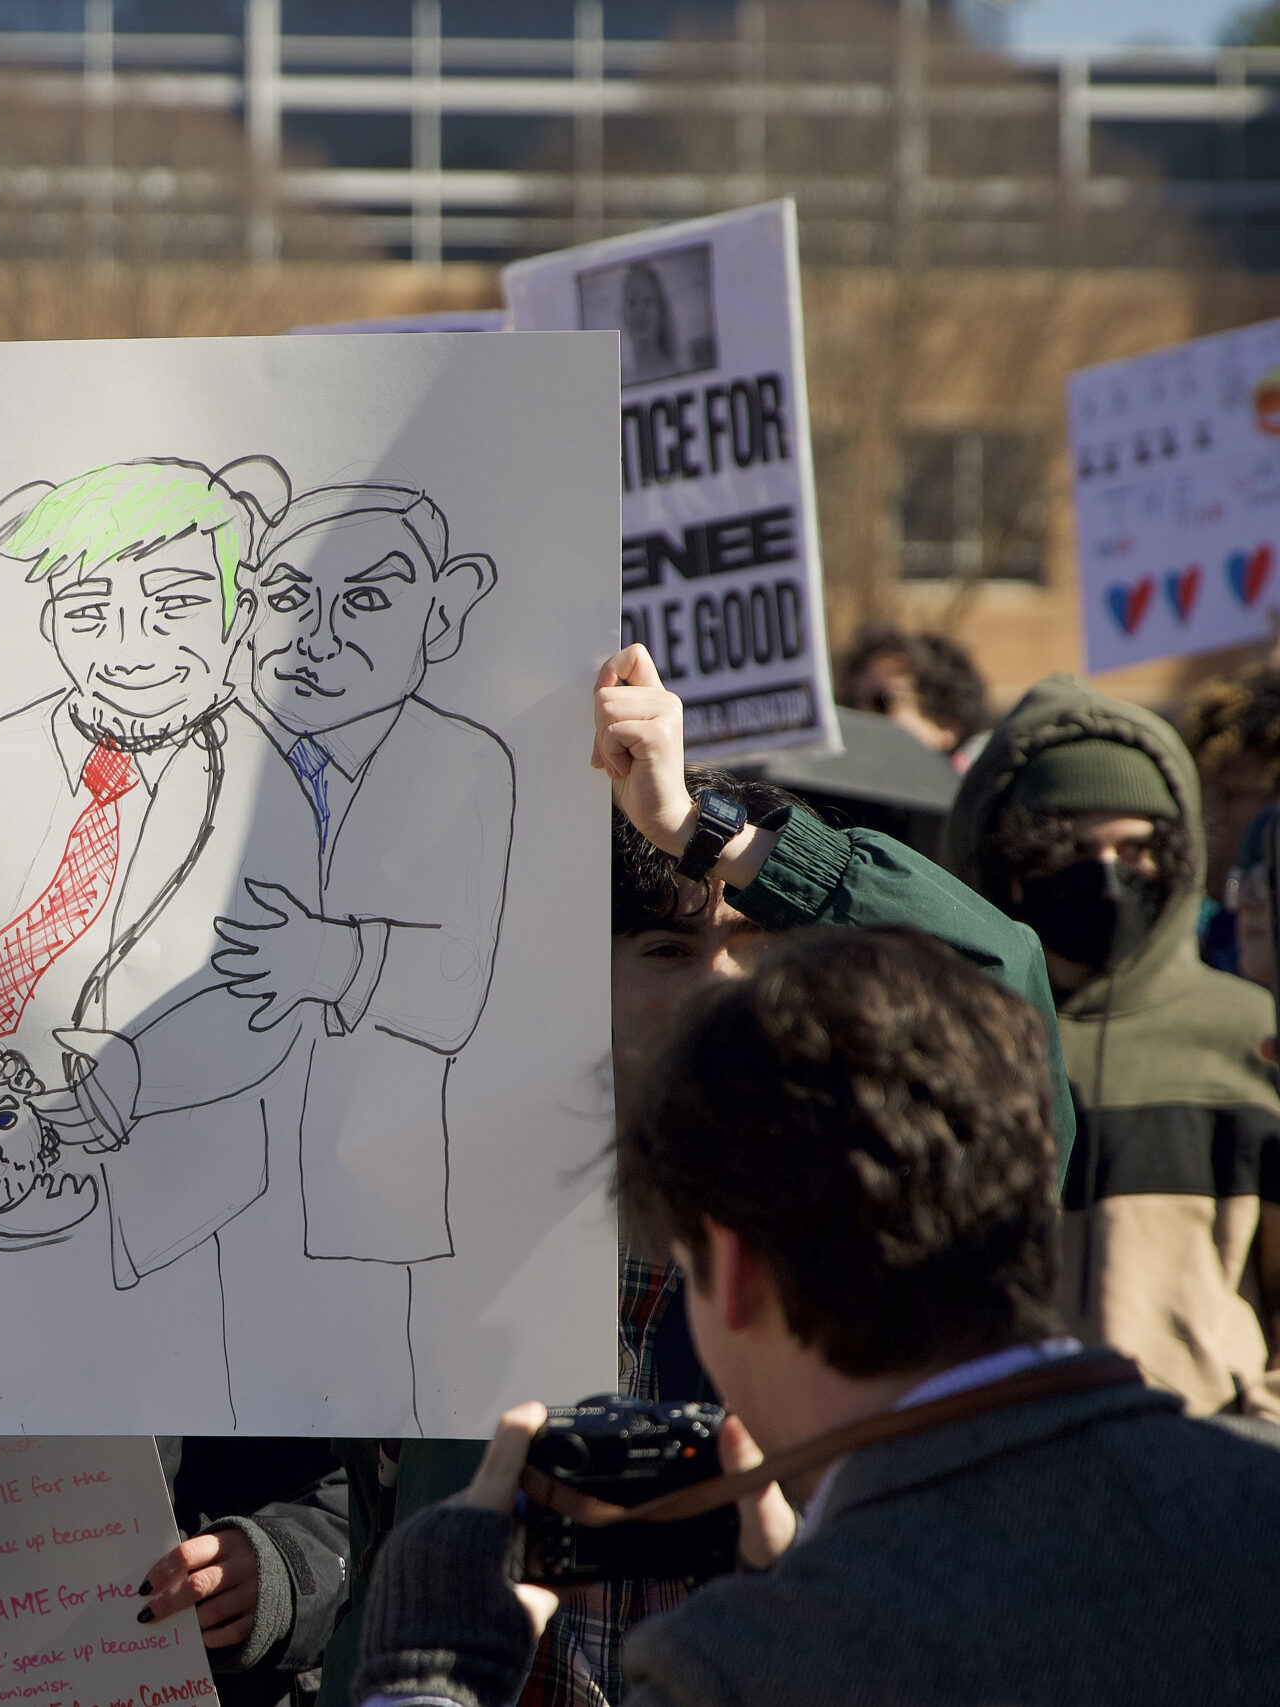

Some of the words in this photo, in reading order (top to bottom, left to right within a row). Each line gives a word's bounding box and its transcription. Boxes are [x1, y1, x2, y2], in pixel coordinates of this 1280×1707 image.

[621, 388, 701, 492] TICE
[705, 373, 788, 470] FOR
[621, 504, 798, 592] ENEE
[694, 578, 806, 676] GOOD
[31, 1474, 64, 1498] for
[72, 1469, 114, 1488] the
[24, 1534, 46, 1553] up
[51, 1520, 127, 1546] because
[57, 1583, 90, 1611] for
[97, 1582, 139, 1603] the
[12, 1649, 68, 1674] speak
[73, 1643, 95, 1663] up
[99, 1634, 170, 1655] because
[0, 1678, 73, 1701] unionist.
